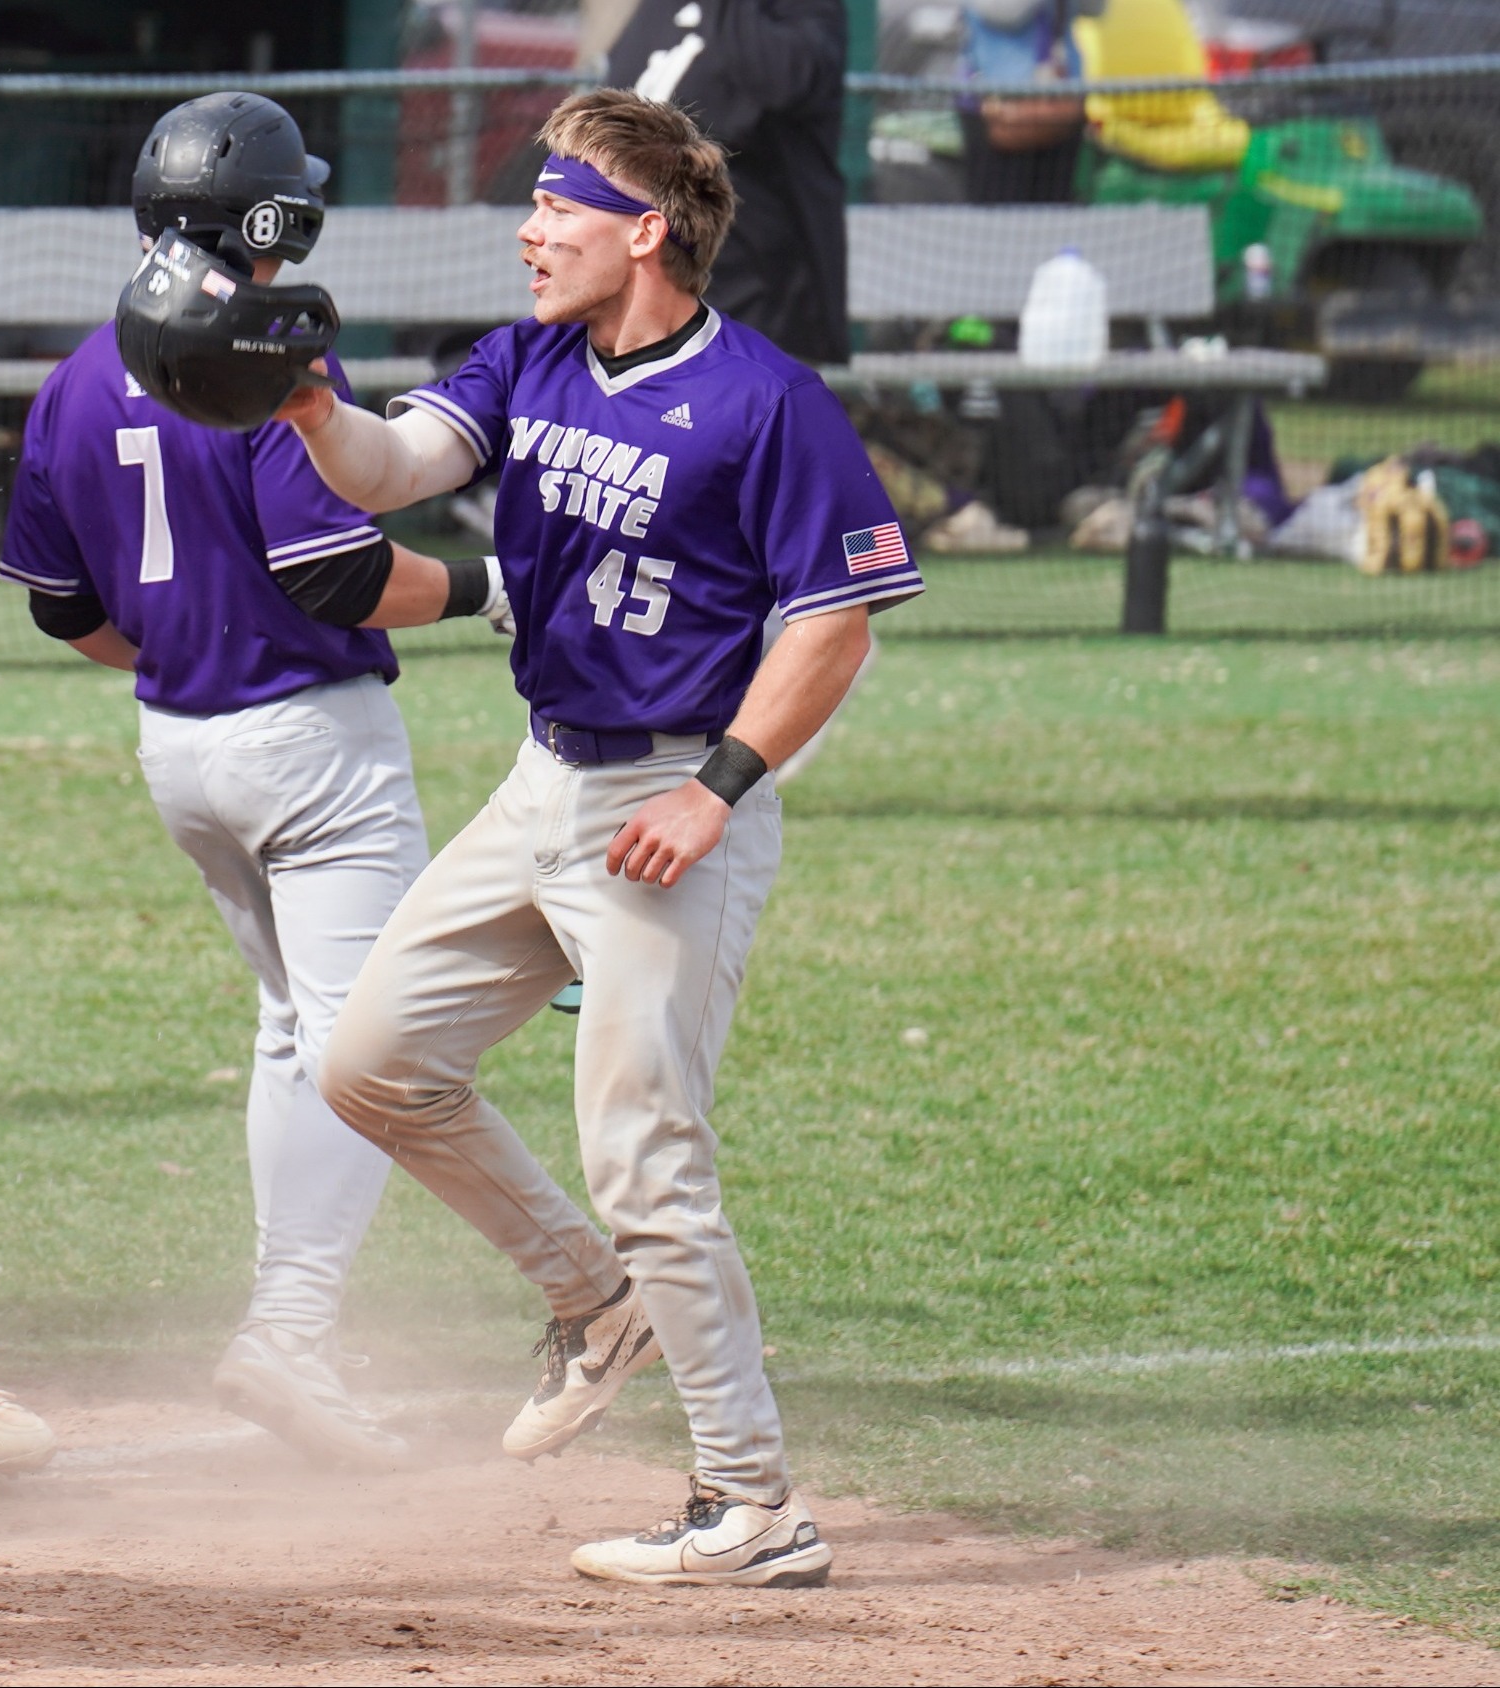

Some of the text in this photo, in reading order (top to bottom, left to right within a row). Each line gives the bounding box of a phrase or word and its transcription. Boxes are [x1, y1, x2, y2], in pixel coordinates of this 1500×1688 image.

[253, 207, 276, 243] 8
[660, 413, 694, 430] adidas
[507, 416, 670, 499] WINONA
[586, 548, 677, 636] 45
